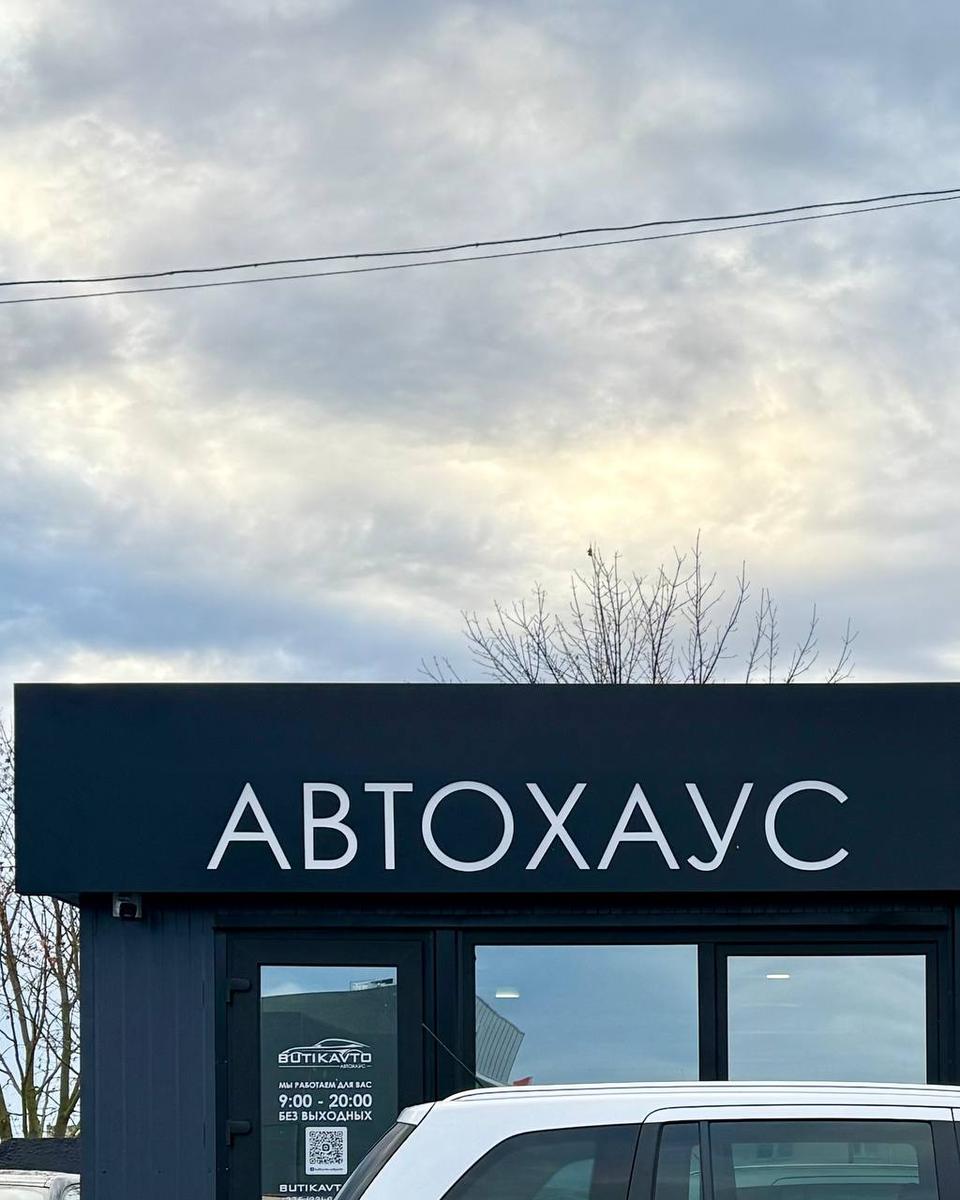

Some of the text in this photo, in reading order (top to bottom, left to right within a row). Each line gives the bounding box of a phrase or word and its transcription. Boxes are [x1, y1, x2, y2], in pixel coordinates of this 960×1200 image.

[207, 780, 850, 872] АВТОХАУС
[278, 1053, 372, 1063] BUTIKAVTO
[294, 1081, 336, 1089] РАБОТАЕМ
[337, 1081, 354, 1089] ДЛЯ
[279, 1094, 312, 1108] 9:00
[329, 1094, 372, 1107] 20:00
[279, 1111, 372, 1122] БЕЗ ВЫХОДНЫХ
[279, 1184, 342, 1192] BUTIKAVT
